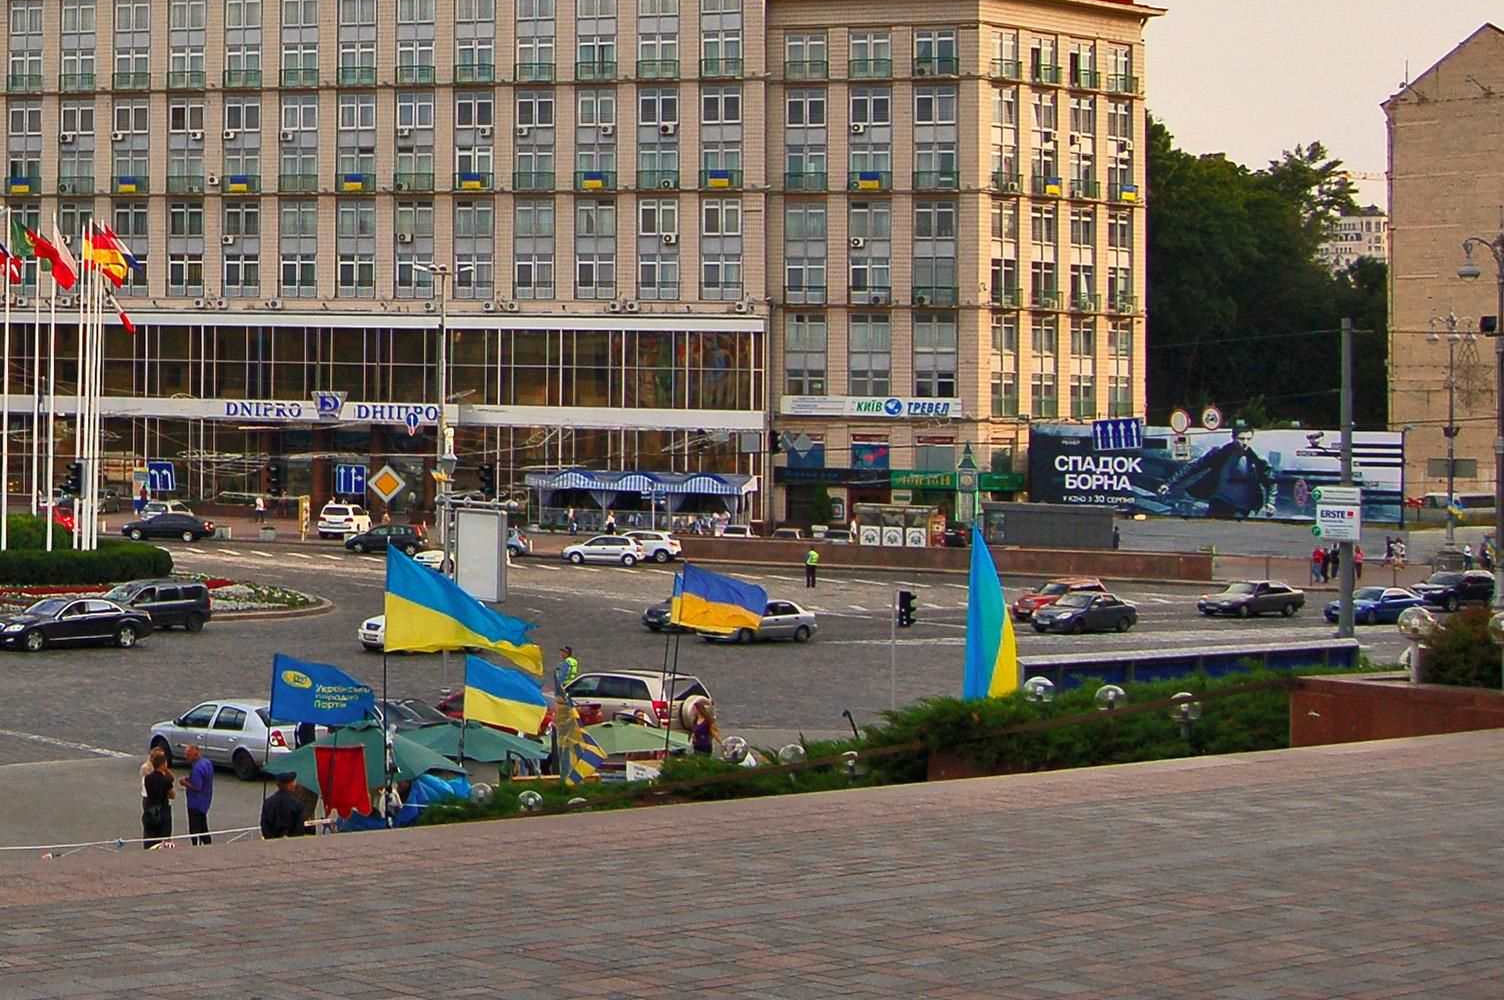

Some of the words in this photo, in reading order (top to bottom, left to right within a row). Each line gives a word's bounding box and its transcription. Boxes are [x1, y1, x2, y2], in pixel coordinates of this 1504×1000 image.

[225, 401, 302, 418] DNIPRO
[856, 400, 883, 412] КИЇВ
[907, 402, 950, 414] ТРЕВЕЛ
[1054, 455, 1143, 475] СПАДОК
[1064, 473, 1132, 491] БОРНА
[1093, 495, 1105, 503] 30
[1320, 510, 1346, 519] ERSTE
